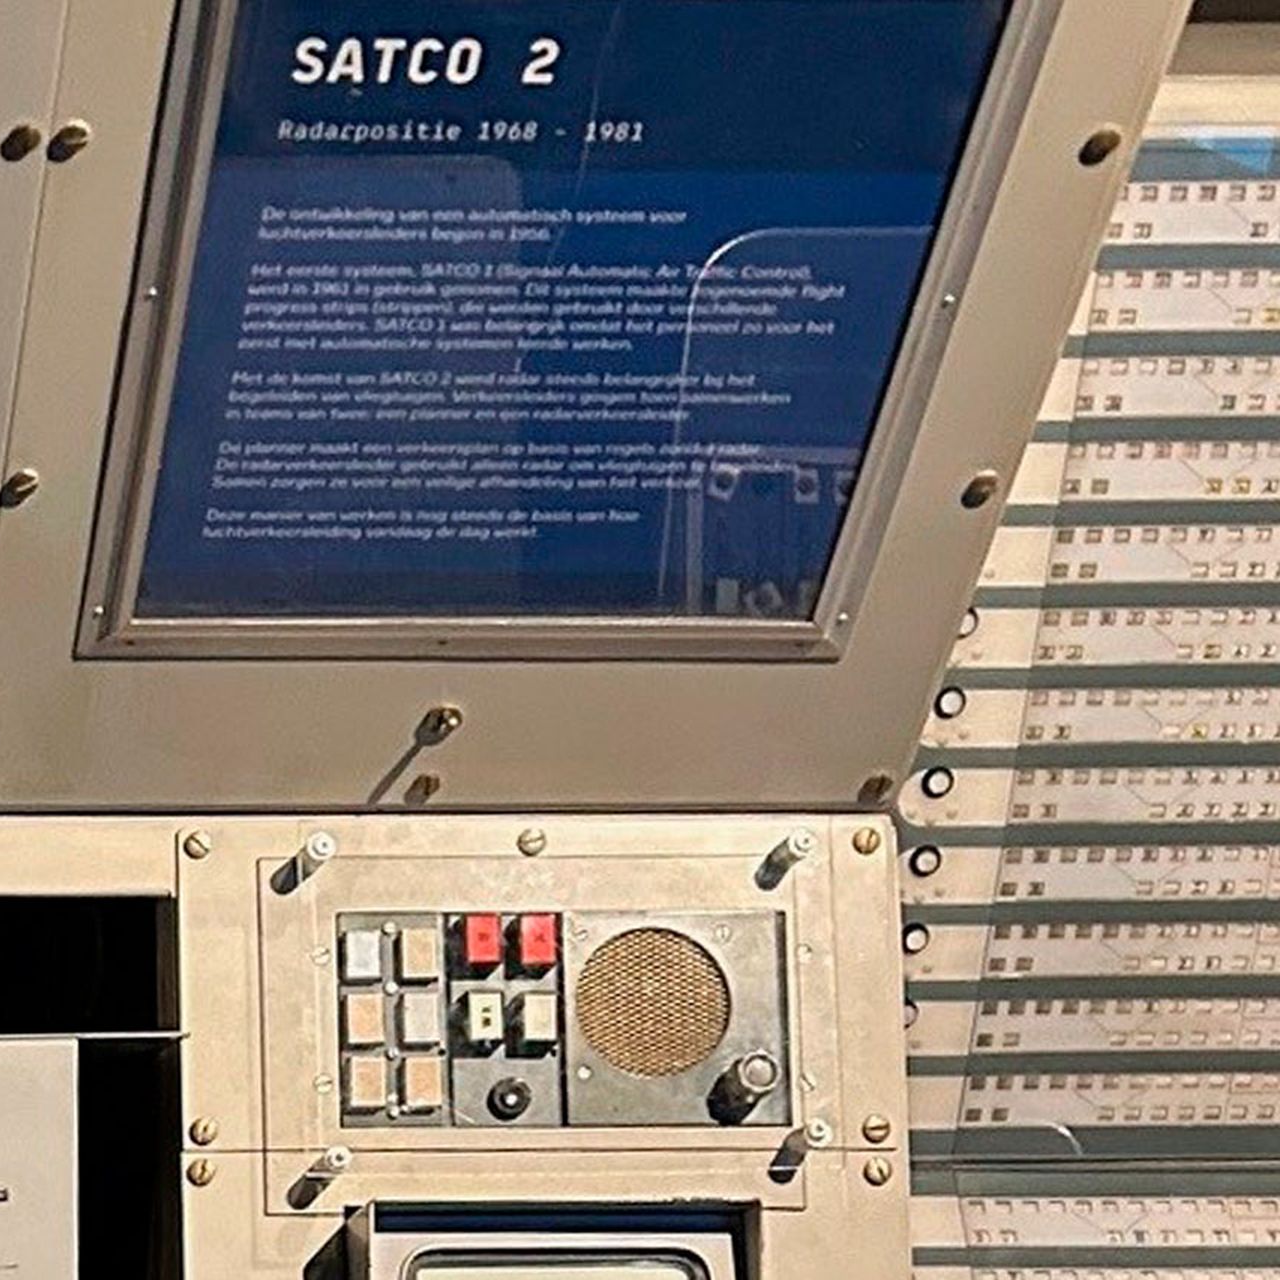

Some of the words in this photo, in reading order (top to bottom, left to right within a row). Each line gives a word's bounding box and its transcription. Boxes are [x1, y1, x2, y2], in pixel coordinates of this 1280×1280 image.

[290, 37, 484, 85] SATCO
[520, 38, 561, 85] 2
[277, 118, 463, 143] Radarpositie
[476, 120, 539, 142] 1968
[583, 120, 645, 142] 1981
[260, 208, 285, 221] De
[398, 211, 428, 221] van
[431, 211, 464, 221] een
[576, 209, 644, 224] systeem
[648, 212, 686, 222] voor
[430, 227, 484, 242] begon
[487, 227, 504, 240] in
[250, 263, 282, 276] Het
[286, 263, 337, 276] eerste
[421, 264, 480, 277] SATCO
[654, 265, 679, 278] Air
[246, 282, 290, 295] werd
[290, 282, 308, 295] in
[312, 282, 348, 295] 1961
[352, 282, 370, 295] in
[372, 282, 436, 297] gebruik
[524, 283, 550, 296] Dit
[554, 283, 622, 298] systeem
[626, 283, 684, 296] maakte
[800, 284, 846, 299] flight
[243, 303, 317, 315] progress
[321, 300, 368, 315] strips
[458, 301, 484, 314] die
[488, 301, 548, 314] werden
[553, 301, 622, 316] gebruikt
[625, 301, 663, 314] door
[375, 318, 433, 331] SATCO
[449, 322, 479, 332] was
[569, 319, 621, 332] omdat
[624, 319, 654, 332] het
[742, 323, 762, 333] zo
[765, 323, 801, 333] voor
[805, 320, 836, 333] het
[236, 336, 280, 349] eerst
[283, 336, 316, 349] met
[436, 337, 512, 352] systemen
[516, 337, 566, 350] leerde
[230, 370, 264, 383] Met
[266, 370, 288, 383] de
[291, 370, 341, 383] komst
[345, 374, 376, 384] van
[380, 371, 437, 384] SATCO
[454, 371, 495, 384] werd
[498, 372, 539, 385] radar
[545, 372, 598, 385] steeds
[702, 373, 724, 388] bij
[726, 373, 757, 386] het
[321, 392, 350, 402] van
[579, 390, 634, 405] gingen
[640, 390, 676, 403] toen
[224, 406, 241, 419] in
[244, 406, 292, 419] teams
[296, 409, 326, 419] van
[375, 410, 406, 420] een
[410, 407, 469, 422] planner
[473, 410, 496, 420] en
[498, 410, 529, 420] een
[217, 441, 241, 454] De
[244, 441, 302, 456] planner
[309, 441, 358, 454] maakt
[361, 444, 392, 454] een
[501, 445, 524, 457] op
[526, 442, 568, 455] basis
[572, 445, 601, 455] van
[604, 442, 654, 457] regels
[214, 458, 238, 471] De
[400, 458, 466, 473] gebruikt
[471, 458, 518, 471] alleen
[521, 459, 563, 472] radar
[567, 462, 594, 472] om
[689, 459, 705, 472] te
[211, 475, 266, 488] Samen
[270, 478, 325, 490] zorgen
[328, 478, 348, 488] ze
[350, 478, 386, 488] voor
[390, 478, 421, 488] een
[424, 475, 474, 490] veilige
[576, 478, 606, 488] van
[608, 475, 637, 488] het
[205, 507, 246, 520] Deze
[250, 507, 302, 520] manier
[306, 510, 336, 520] van
[339, 507, 396, 520] werken
[399, 507, 413, 520] is
[416, 510, 447, 522] nog
[451, 508, 502, 521] steeds
[506, 508, 527, 521] de
[531, 508, 572, 521] basis
[576, 511, 604, 521] van
[608, 508, 640, 521] hoe
[366, 524, 432, 539] vandaag
[435, 524, 455, 537] de
[459, 524, 490, 539] dag
